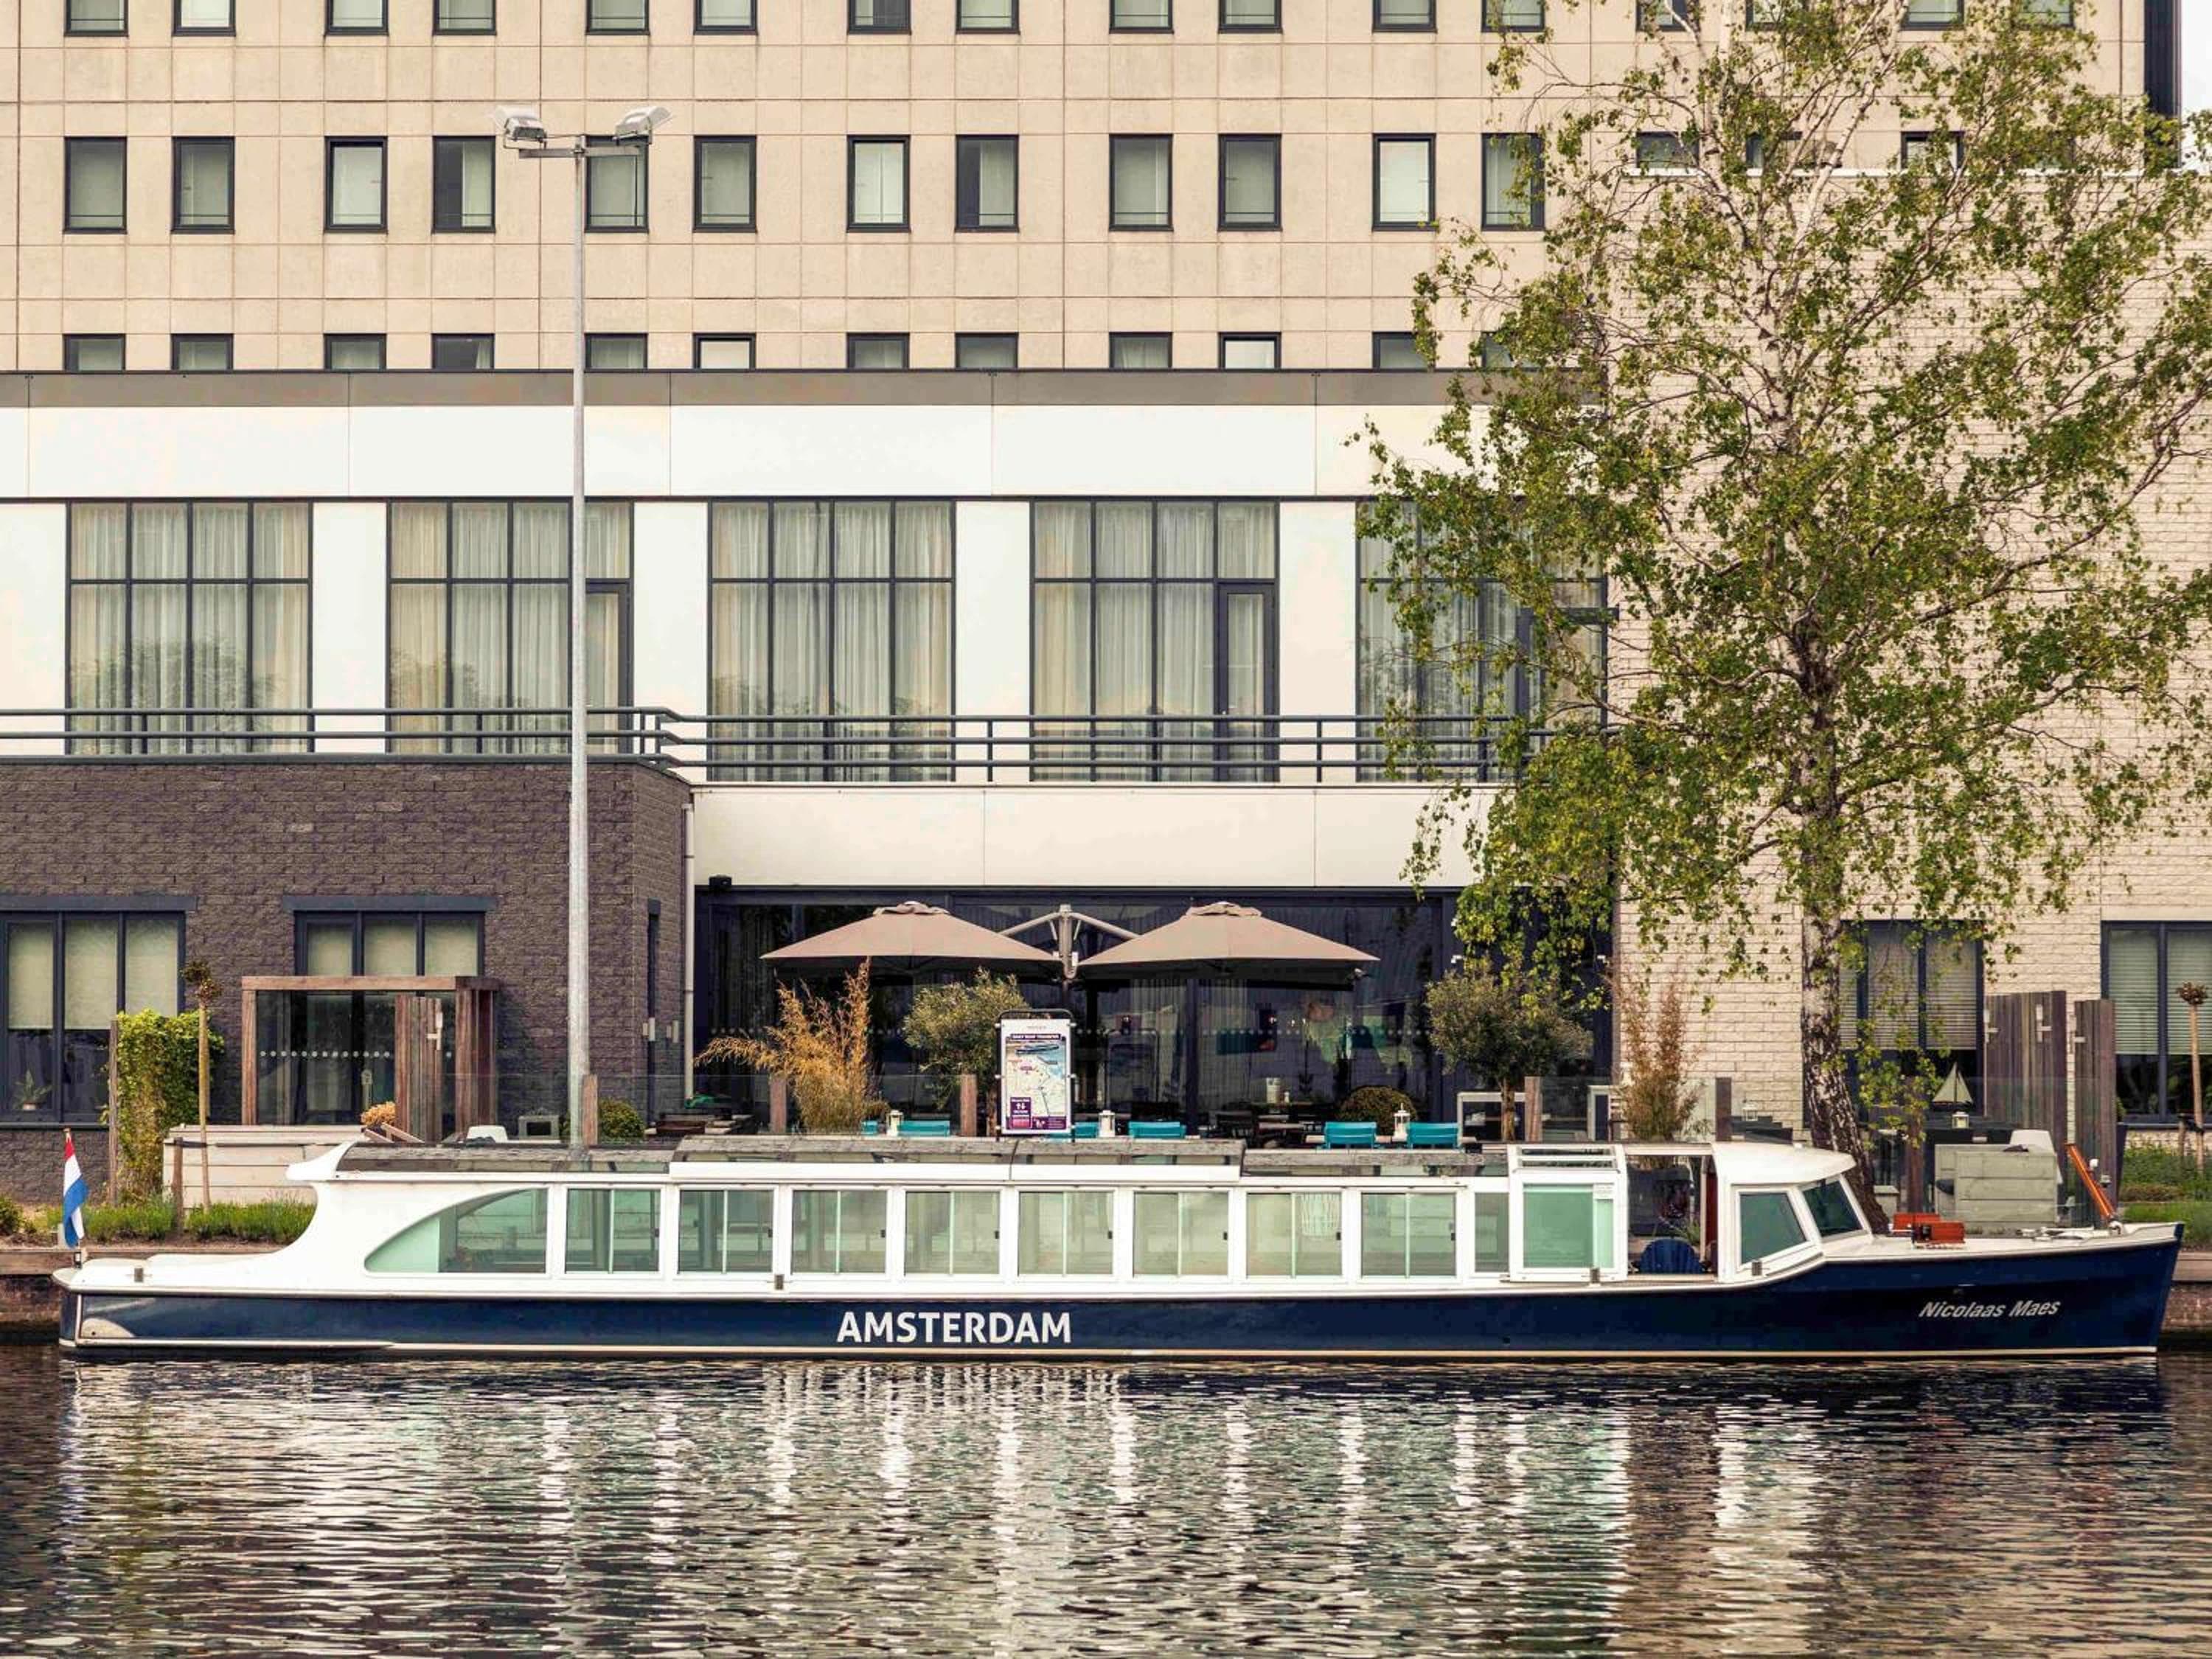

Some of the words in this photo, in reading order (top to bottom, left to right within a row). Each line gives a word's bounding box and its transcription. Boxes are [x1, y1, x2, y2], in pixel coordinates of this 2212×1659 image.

[1919, 1301, 2006, 1318] Nicolaas
[2008, 1300, 2062, 1317] Maes
[836, 1311, 1071, 1343] AMSTERDAM
